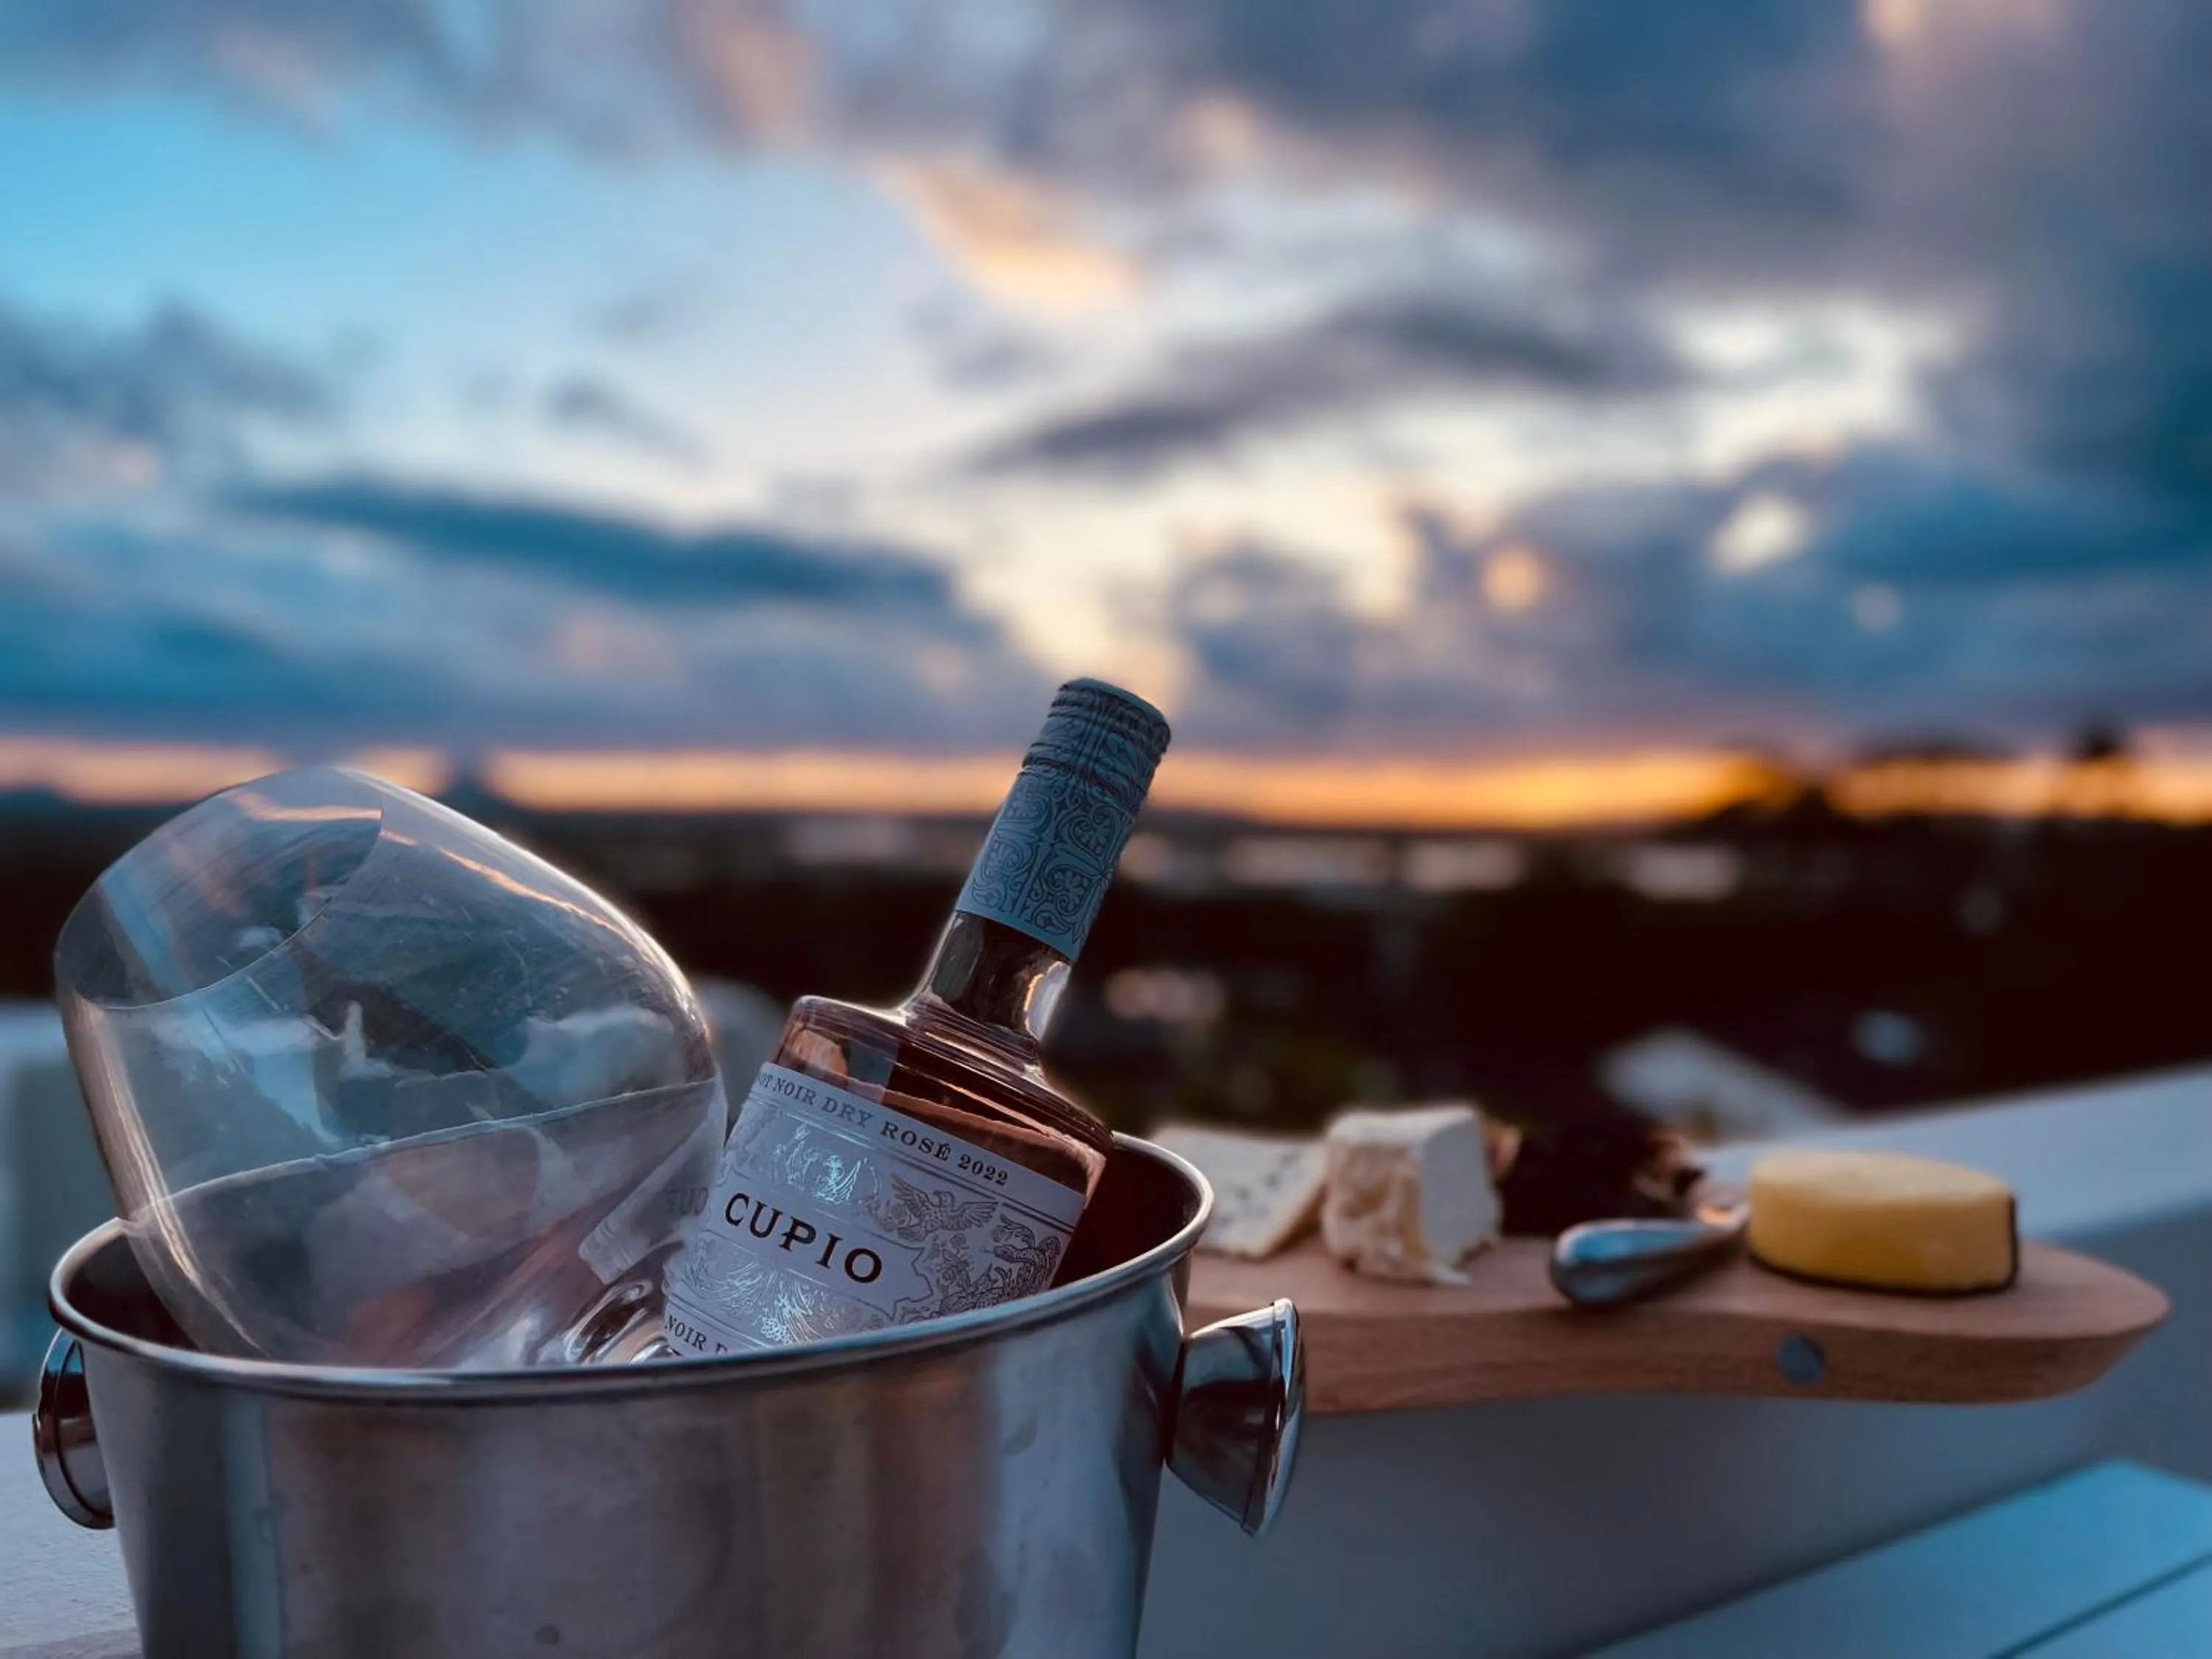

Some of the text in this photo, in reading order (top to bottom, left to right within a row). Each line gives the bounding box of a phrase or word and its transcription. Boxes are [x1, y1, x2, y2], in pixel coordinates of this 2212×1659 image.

[773, 1077, 817, 1105] NOIR
[821, 1096, 874, 1128] DRY
[880, 1121, 953, 1161] ROSÉ
[958, 1153, 1009, 1187] 2022
[725, 1193, 883, 1284] CUPIO
[664, 1315, 706, 1352] NOIR
